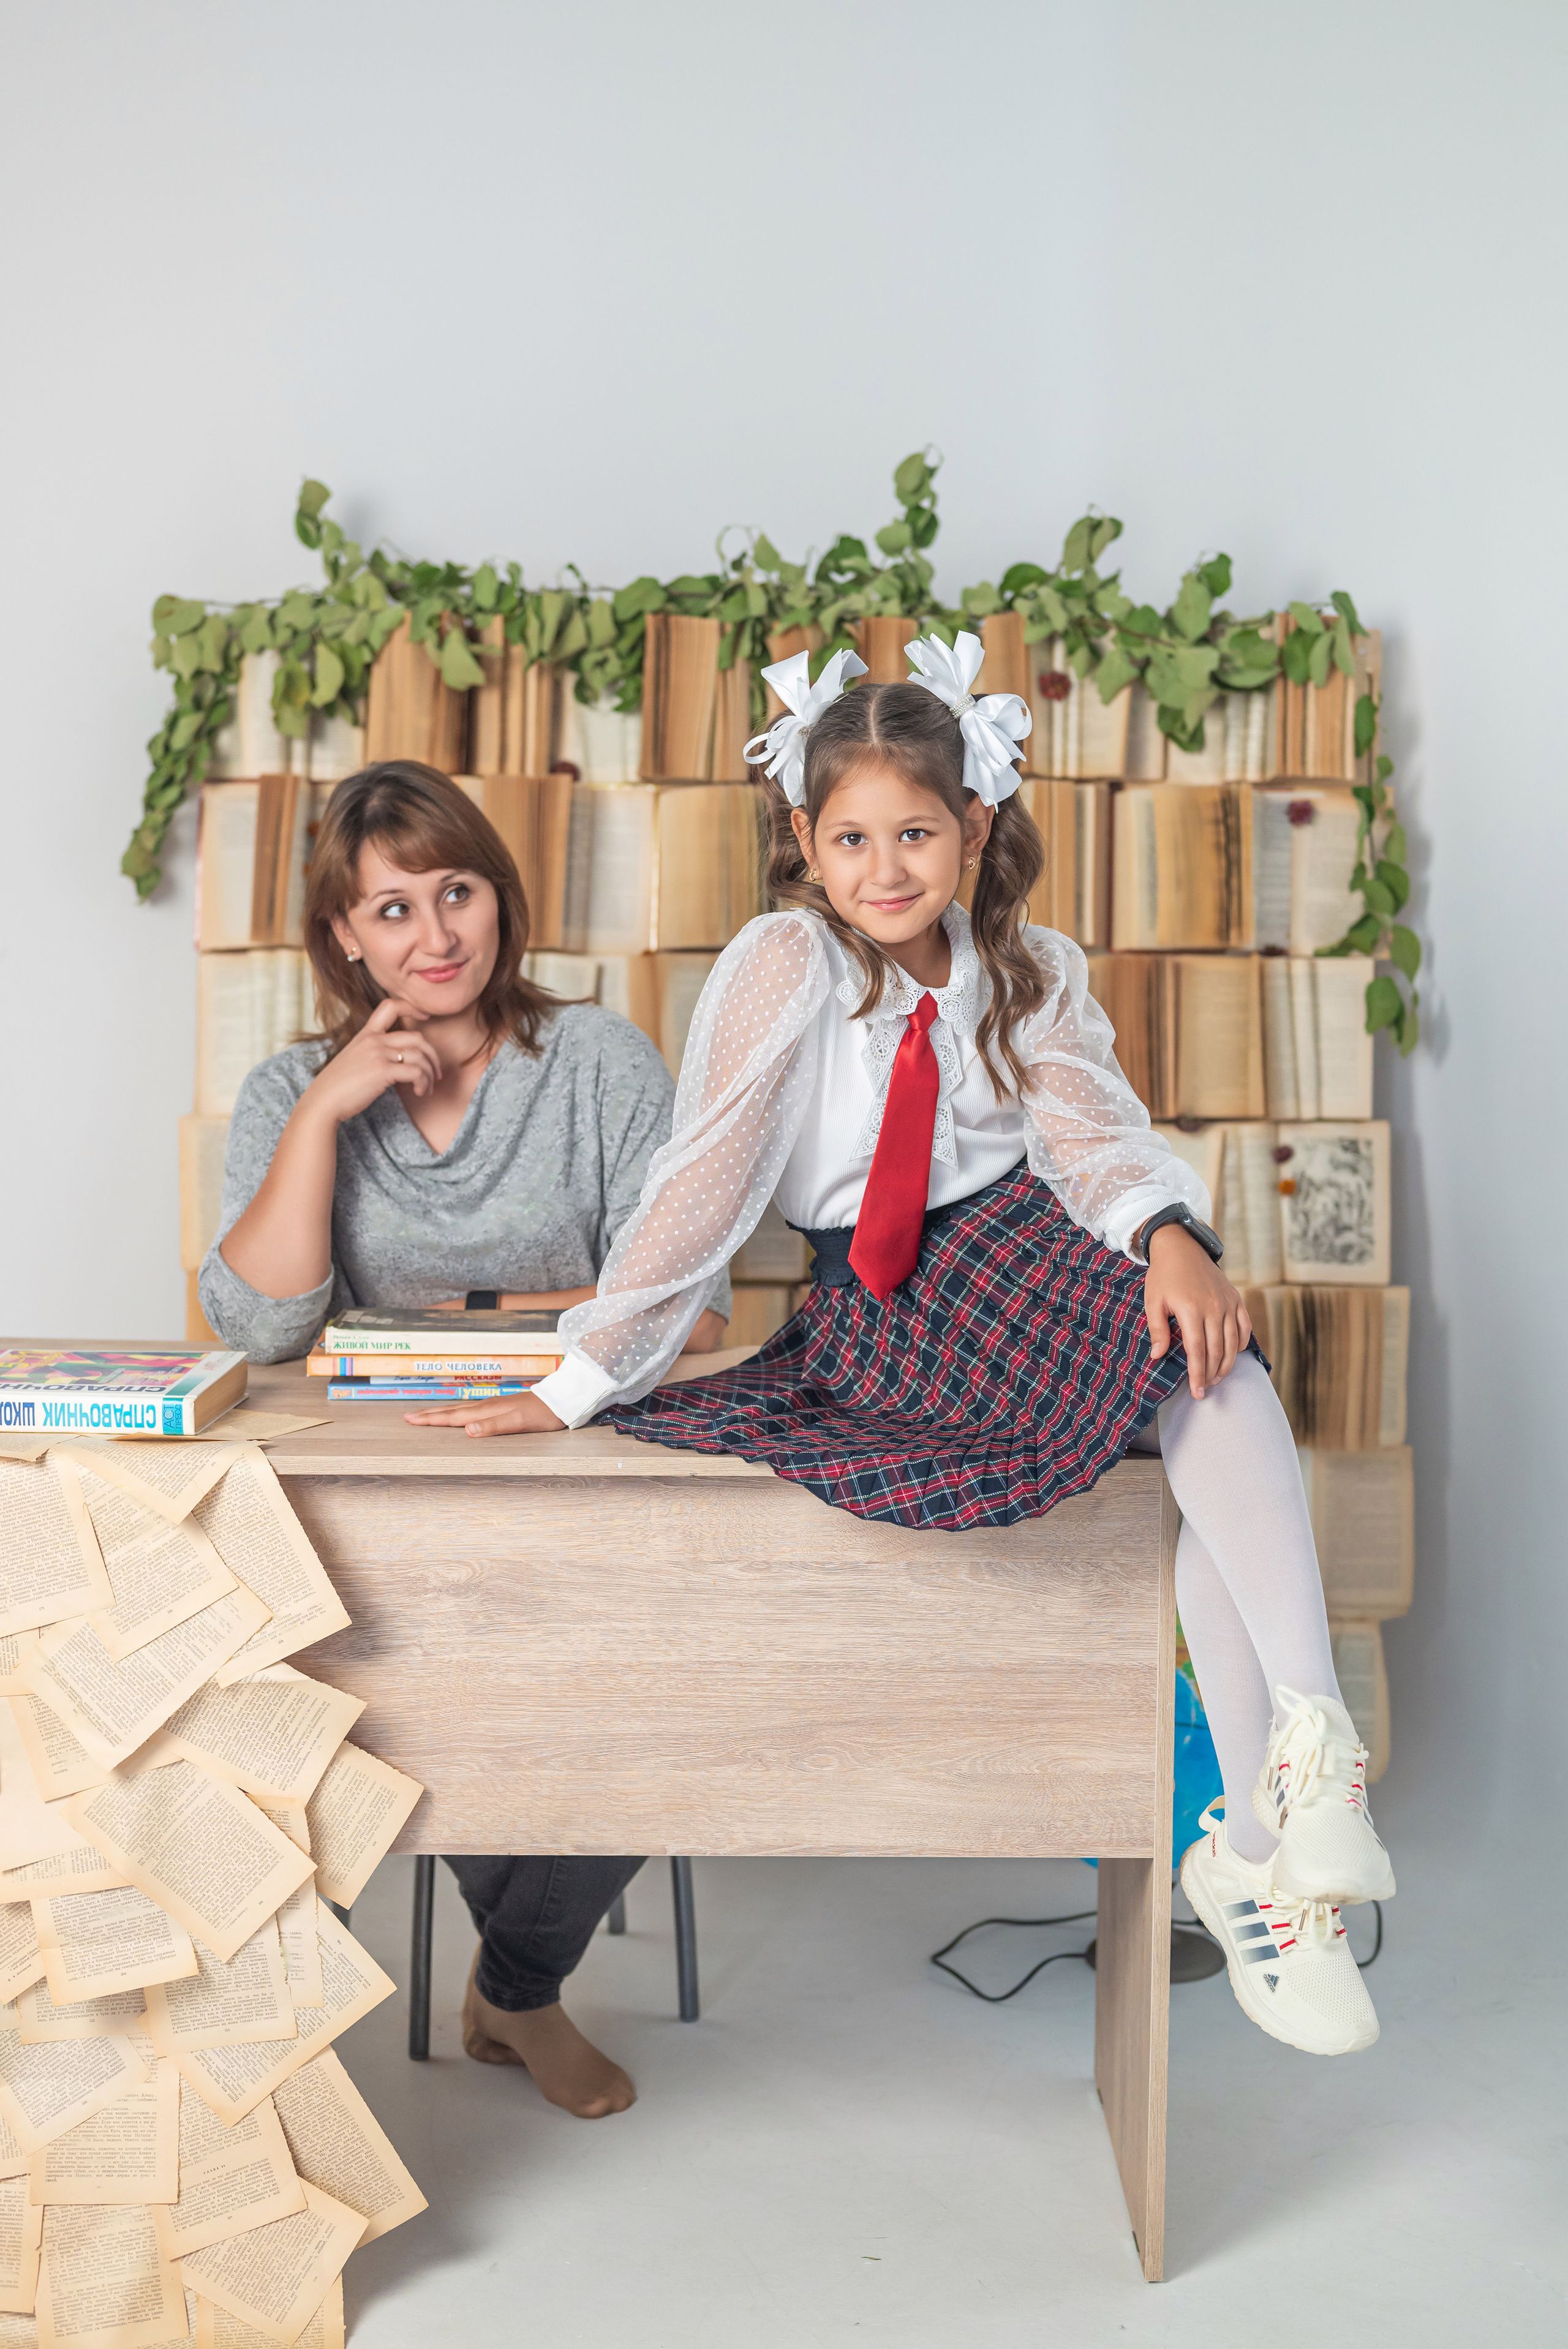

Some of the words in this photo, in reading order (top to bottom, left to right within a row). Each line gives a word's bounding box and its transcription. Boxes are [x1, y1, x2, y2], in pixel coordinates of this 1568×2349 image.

[333, 1341, 368, 1349] ЖИВОЙ
[0, 1383, 167, 1393] СПРАВОЧН
[42, 1402, 156, 1428] СПРАВОЧНИК
[164, 1404, 175, 1429] АСТ
[1263, 1974, 1276, 1993] adidas
[203, 2166, 219, 2175] ГЛАВА
